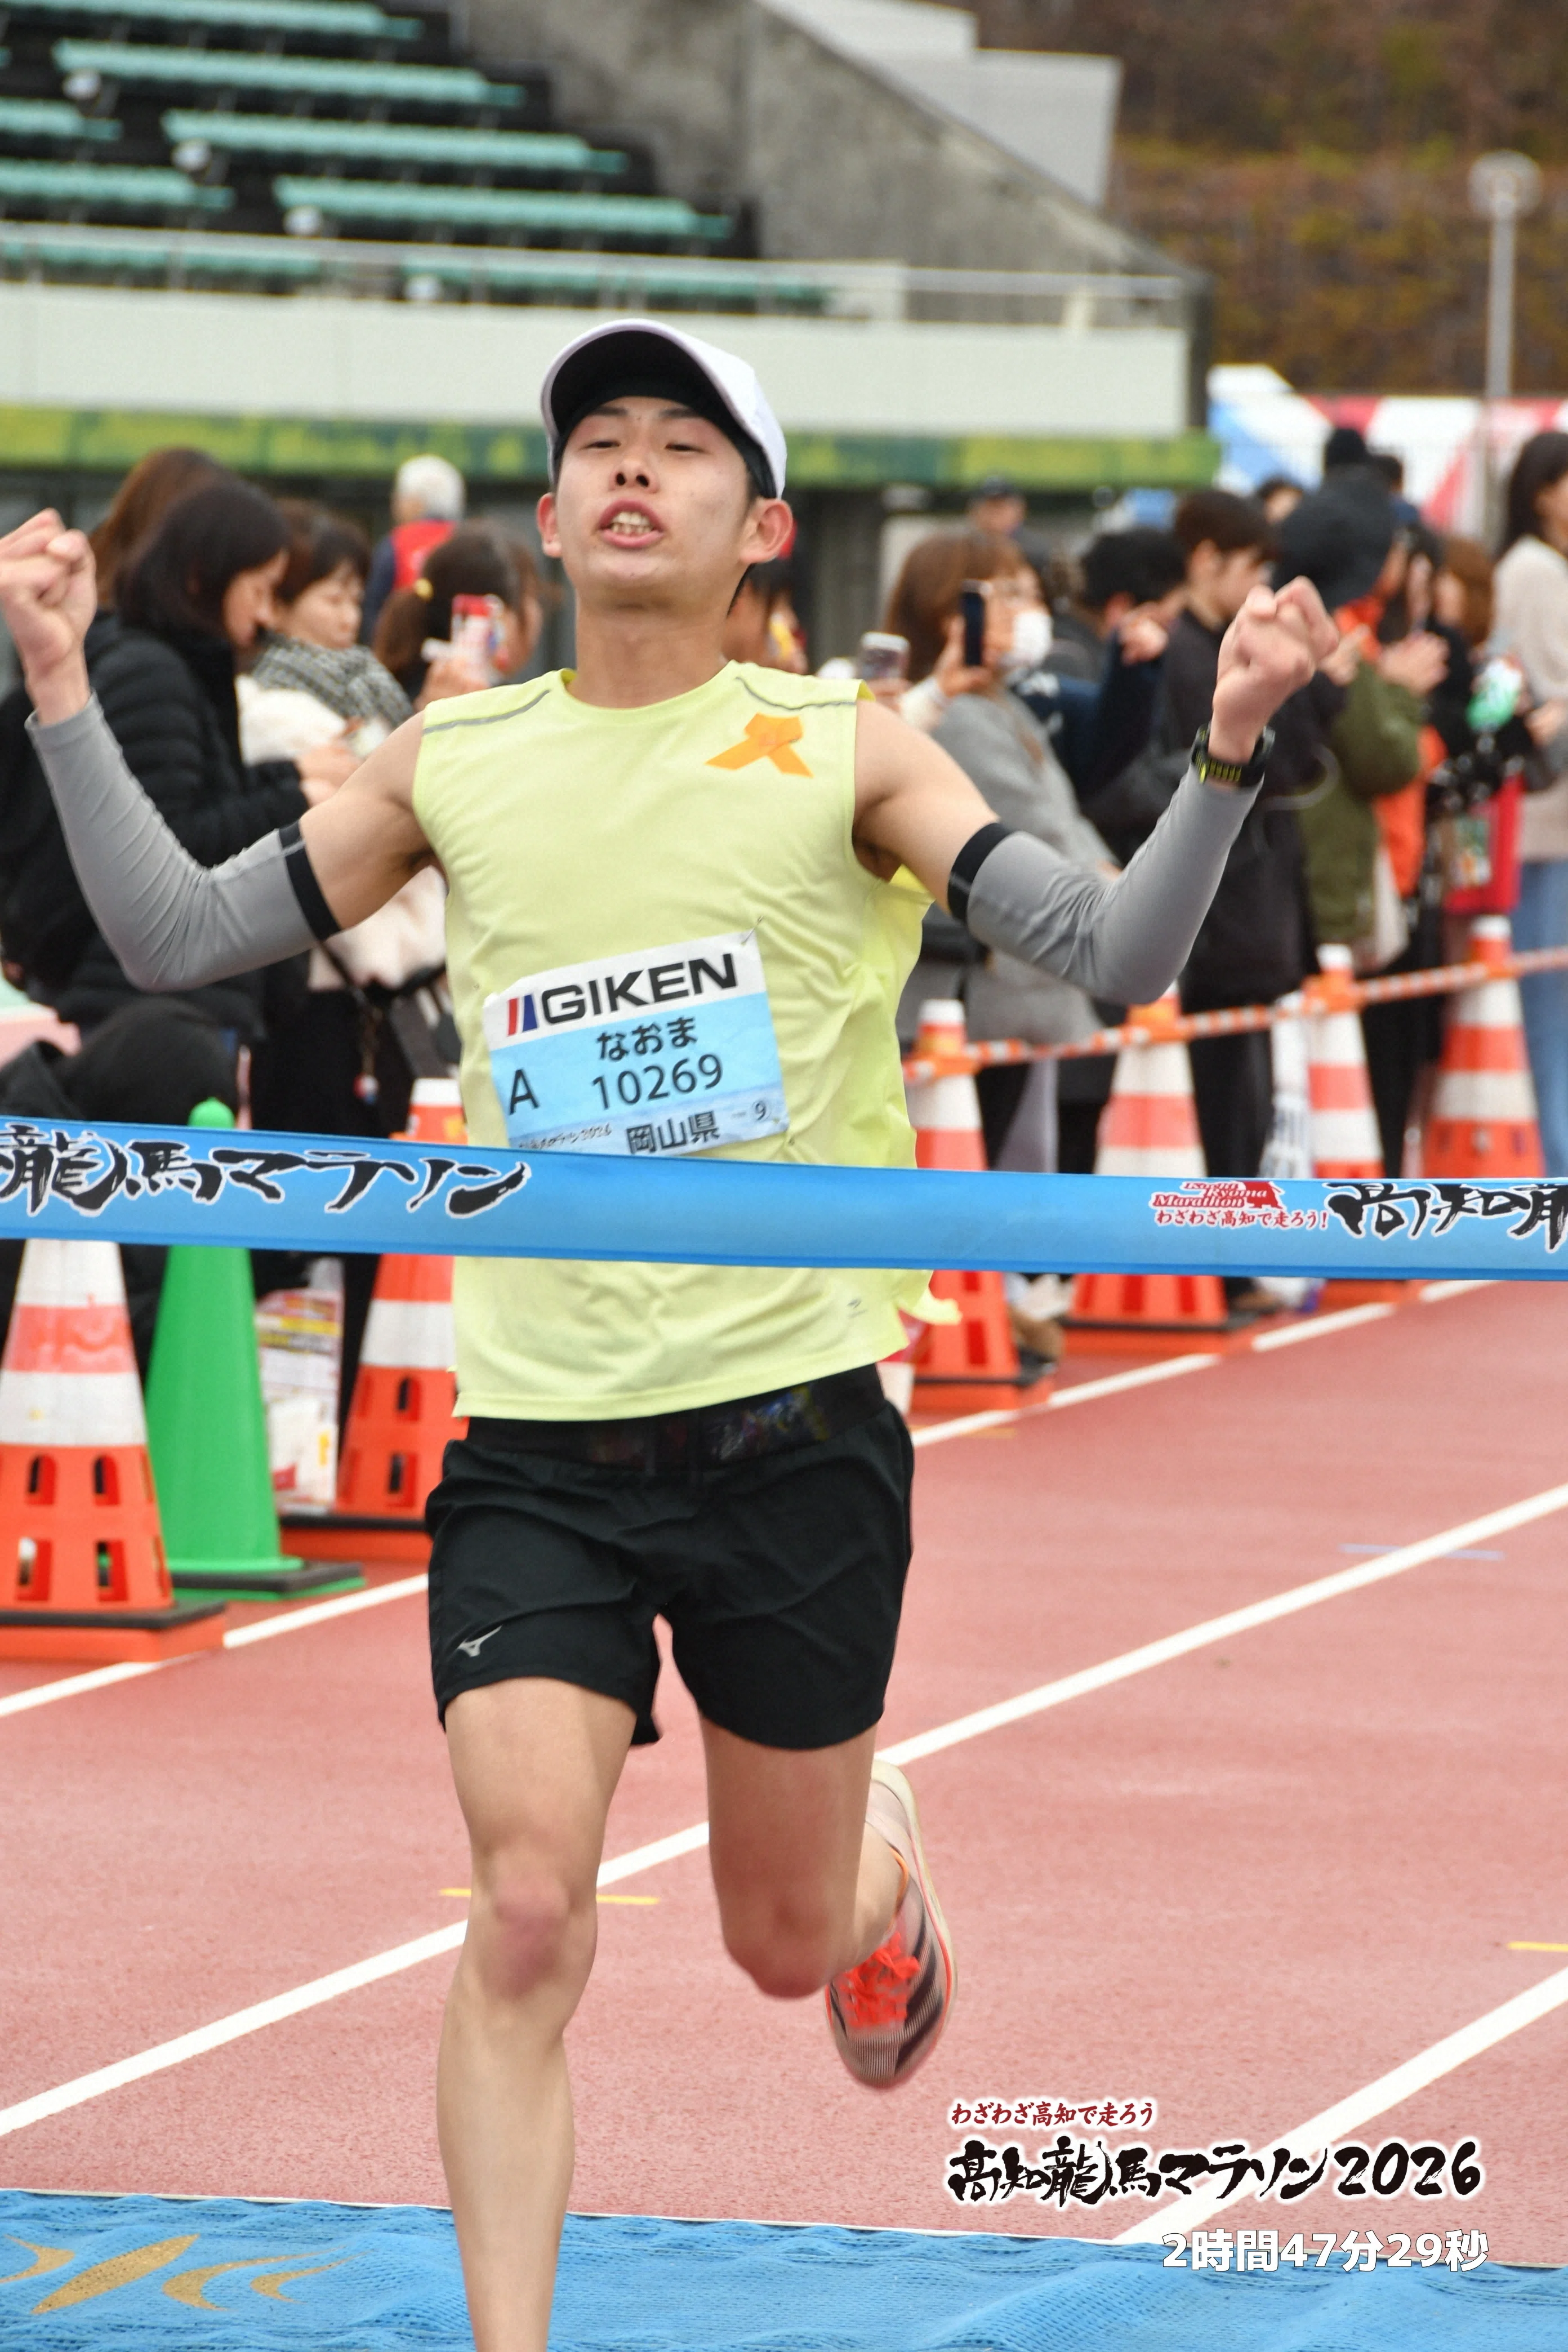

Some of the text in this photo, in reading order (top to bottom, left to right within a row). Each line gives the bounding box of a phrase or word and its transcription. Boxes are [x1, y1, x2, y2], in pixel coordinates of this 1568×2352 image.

[542, 953, 738, 1024] GIKEN
[596, 1016, 698, 1062] なおま
[508, 1053, 723, 1116] A 10269
[626, 1110, 720, 1155] 岡山県
[0, 1124, 528, 1217] 龍馬マラソン
[1205, 1187, 1268, 1199] Ryoma
[1153, 1193, 1245, 1208] Marathon
